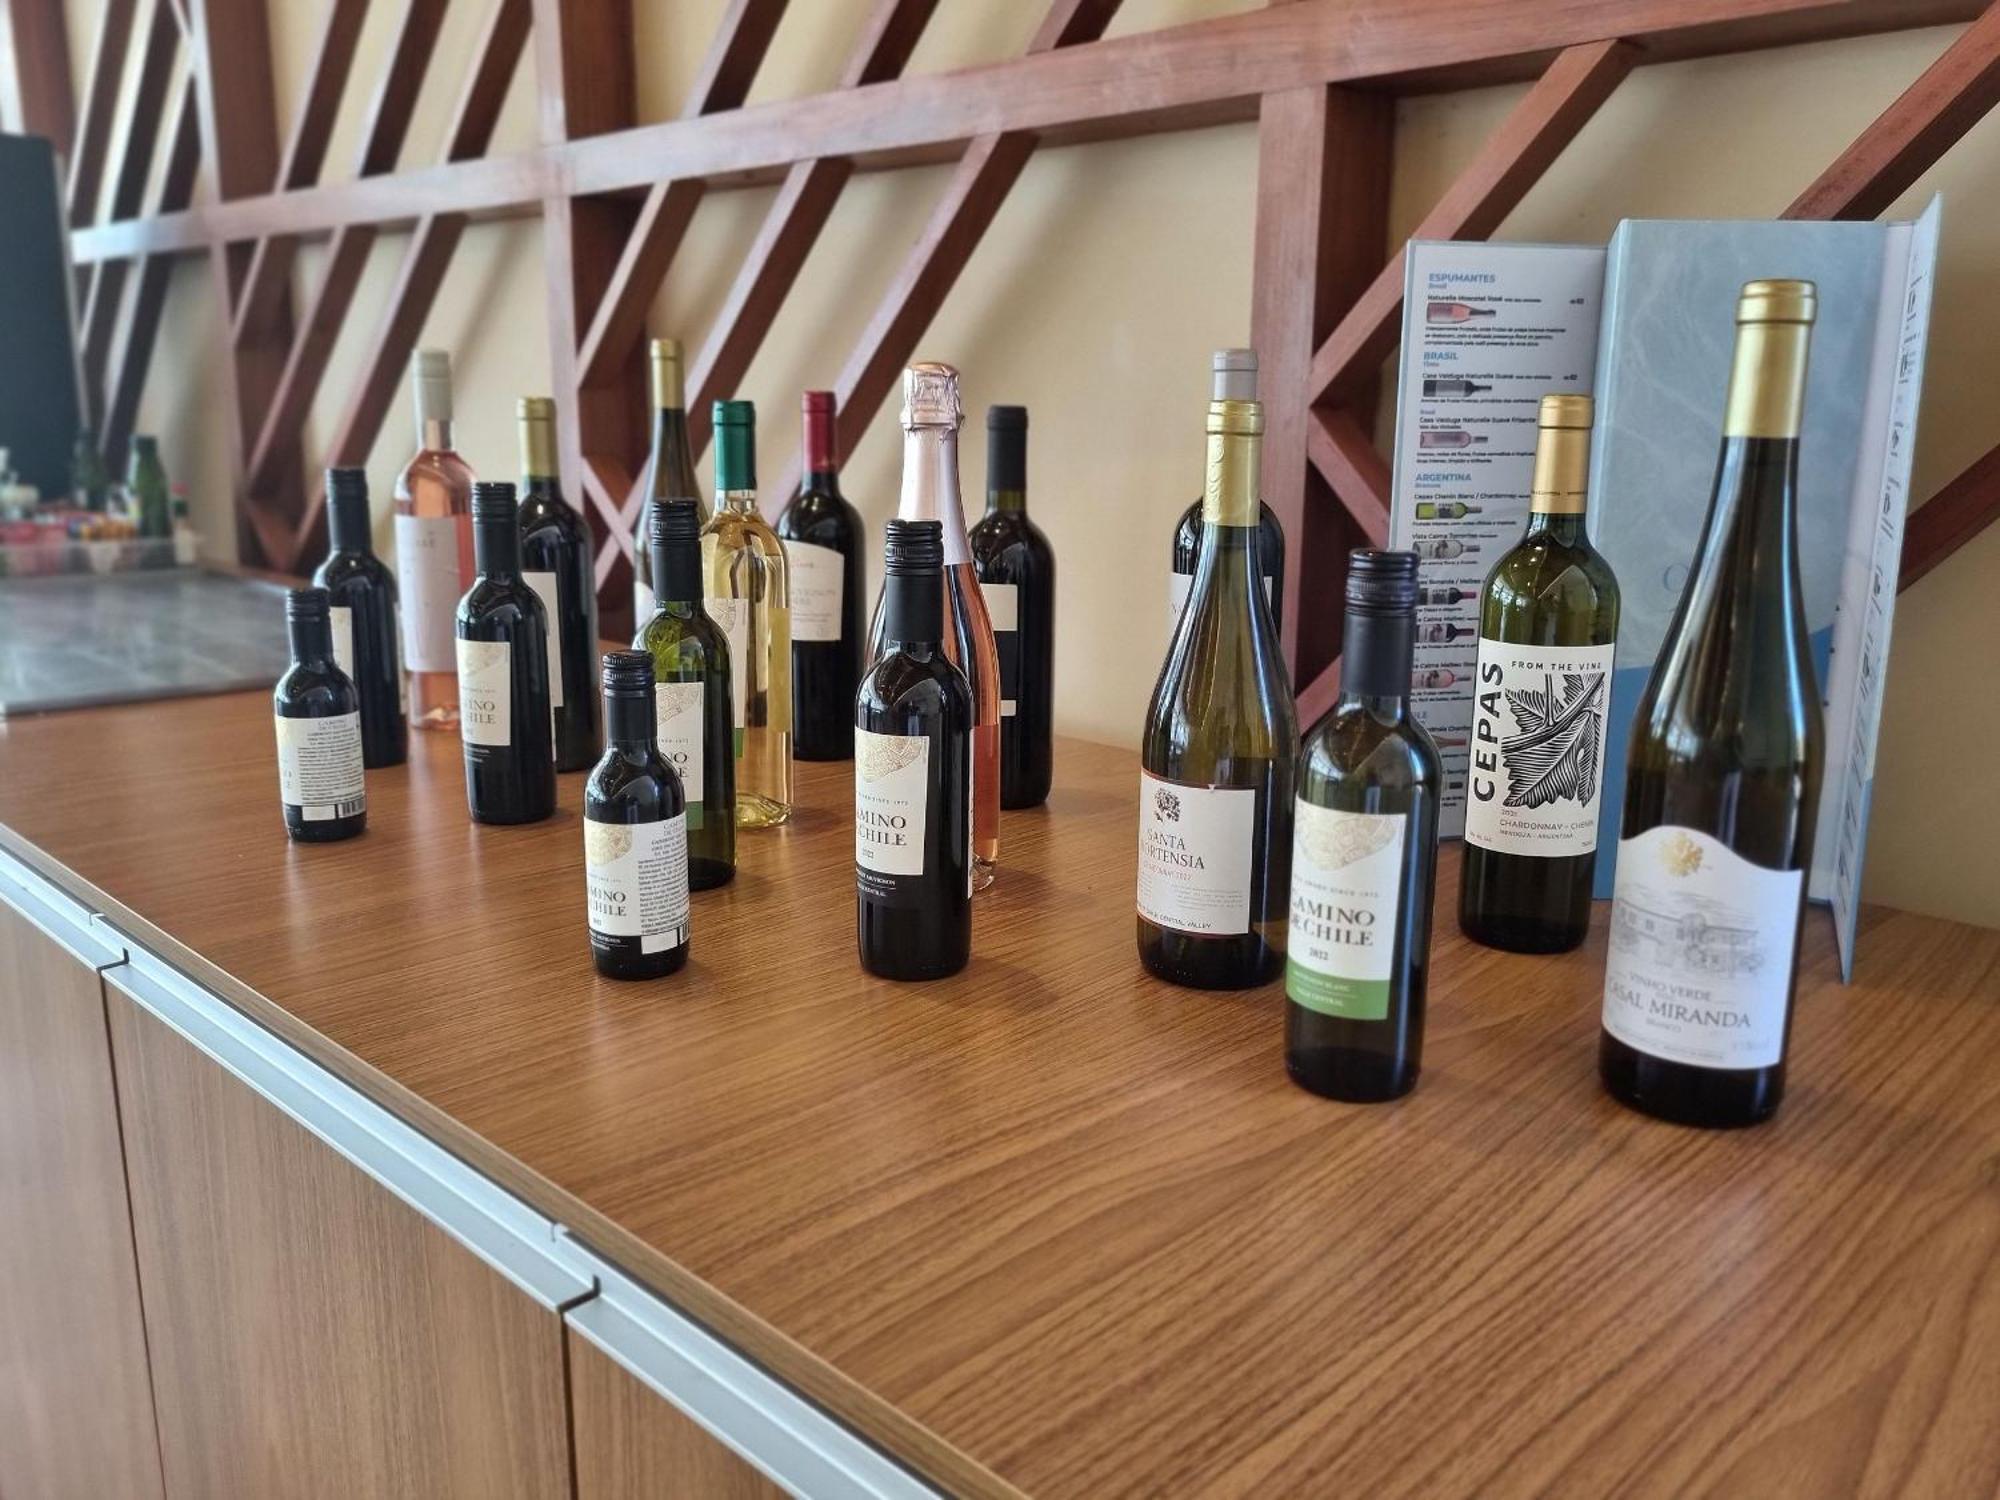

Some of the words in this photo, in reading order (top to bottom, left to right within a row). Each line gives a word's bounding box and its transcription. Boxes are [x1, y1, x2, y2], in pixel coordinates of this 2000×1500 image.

[1429, 273, 1496, 283] ESPUMANTES
[1423, 352, 1459, 360] BRASIL
[1416, 473, 1472, 481] ARGENTINA
[1511, 660, 1544, 671] FROM
[1551, 663, 1573, 671] THE
[1474, 661, 1504, 802] CEPAS
[1500, 819, 1563, 830] CHARDONNAY
[1147, 828, 1186, 850] SANTA
[593, 899, 628, 917] HILE
[1303, 917, 1374, 946] CHILE
[1669, 983, 1713, 1001] VERDE
[1648, 999, 1752, 1028] MIRANDA
